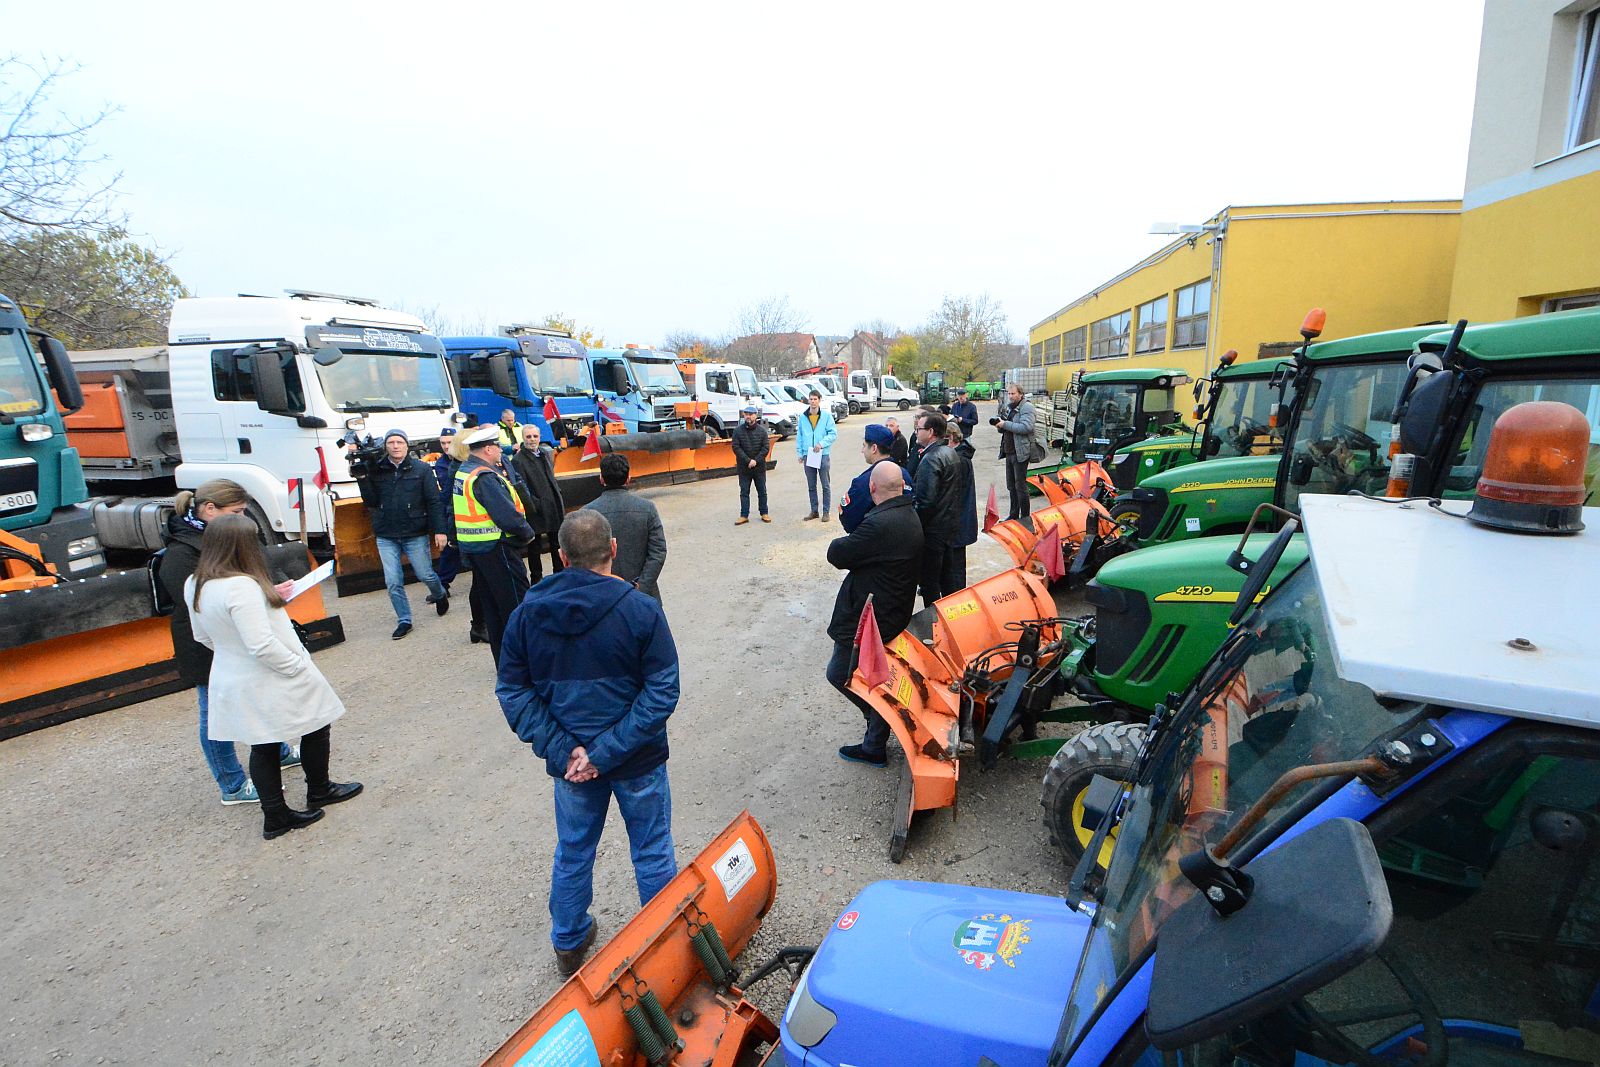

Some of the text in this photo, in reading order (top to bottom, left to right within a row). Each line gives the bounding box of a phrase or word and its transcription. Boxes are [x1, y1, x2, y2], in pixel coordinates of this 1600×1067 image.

[1181, 481, 1201, 489] 4720
[1245, 477, 1275, 485] DEERE
[1175, 585, 1213, 596] 4720
[992, 590, 1019, 605] PU-2100
[727, 855, 740, 870] TÜV
